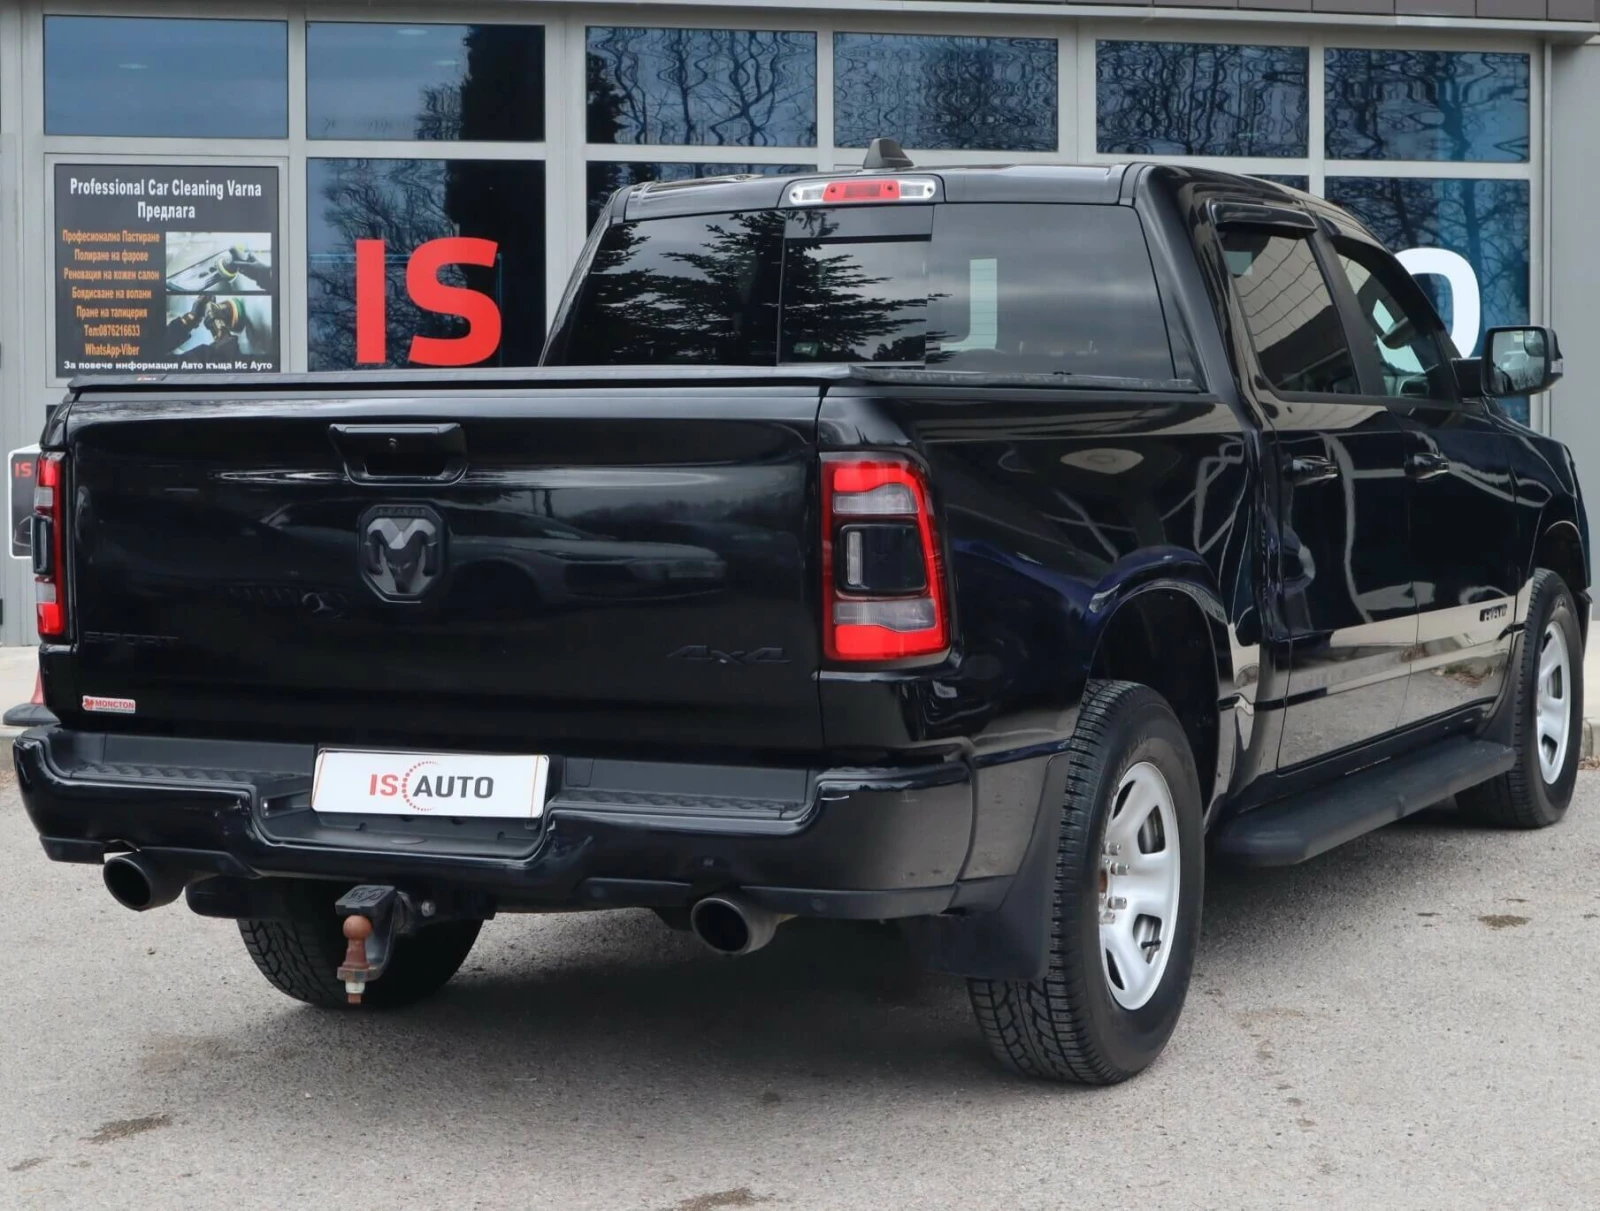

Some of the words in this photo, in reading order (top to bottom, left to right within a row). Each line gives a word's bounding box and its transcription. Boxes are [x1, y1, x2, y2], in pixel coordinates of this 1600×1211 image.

[70, 178, 145, 195] Professional
[148, 179, 169, 196] Car
[172, 179, 224, 200] Cleaning
[227, 180, 262, 197] Varna
[137, 201, 196, 222] Предлага
[62, 229, 120, 245] Професионално
[122, 230, 160, 245] Пастиране
[74, 248, 110, 263] Полиране
[111, 252, 120, 261] на
[121, 249, 149, 264] фарове
[63, 267, 102, 281] Реновация
[103, 270, 112, 280] на
[113, 270, 136, 280] кожен
[138, 270, 160, 280] салон
[72, 286, 114, 300] Боядисване
[115, 289, 125, 299] на
[126, 289, 152, 299] волани
[356, 237, 502, 366] IS
[76, 305, 99, 320] Пране
[100, 308, 109, 317] на
[110, 308, 148, 320] тапицерия
[84, 343, 140, 358] WhatsApp-Viber
[64, 361, 76, 369] За
[115, 360, 179, 371] информация
[181, 361, 203, 370] Авто
[205, 362, 232, 370] къща
[234, 361, 248, 369] Ис
[250, 361, 273, 371] Ауто
[95, 700, 135, 709] MONCTON
[369, 774, 398, 796] IS
[412, 775, 494, 799] AUTO
